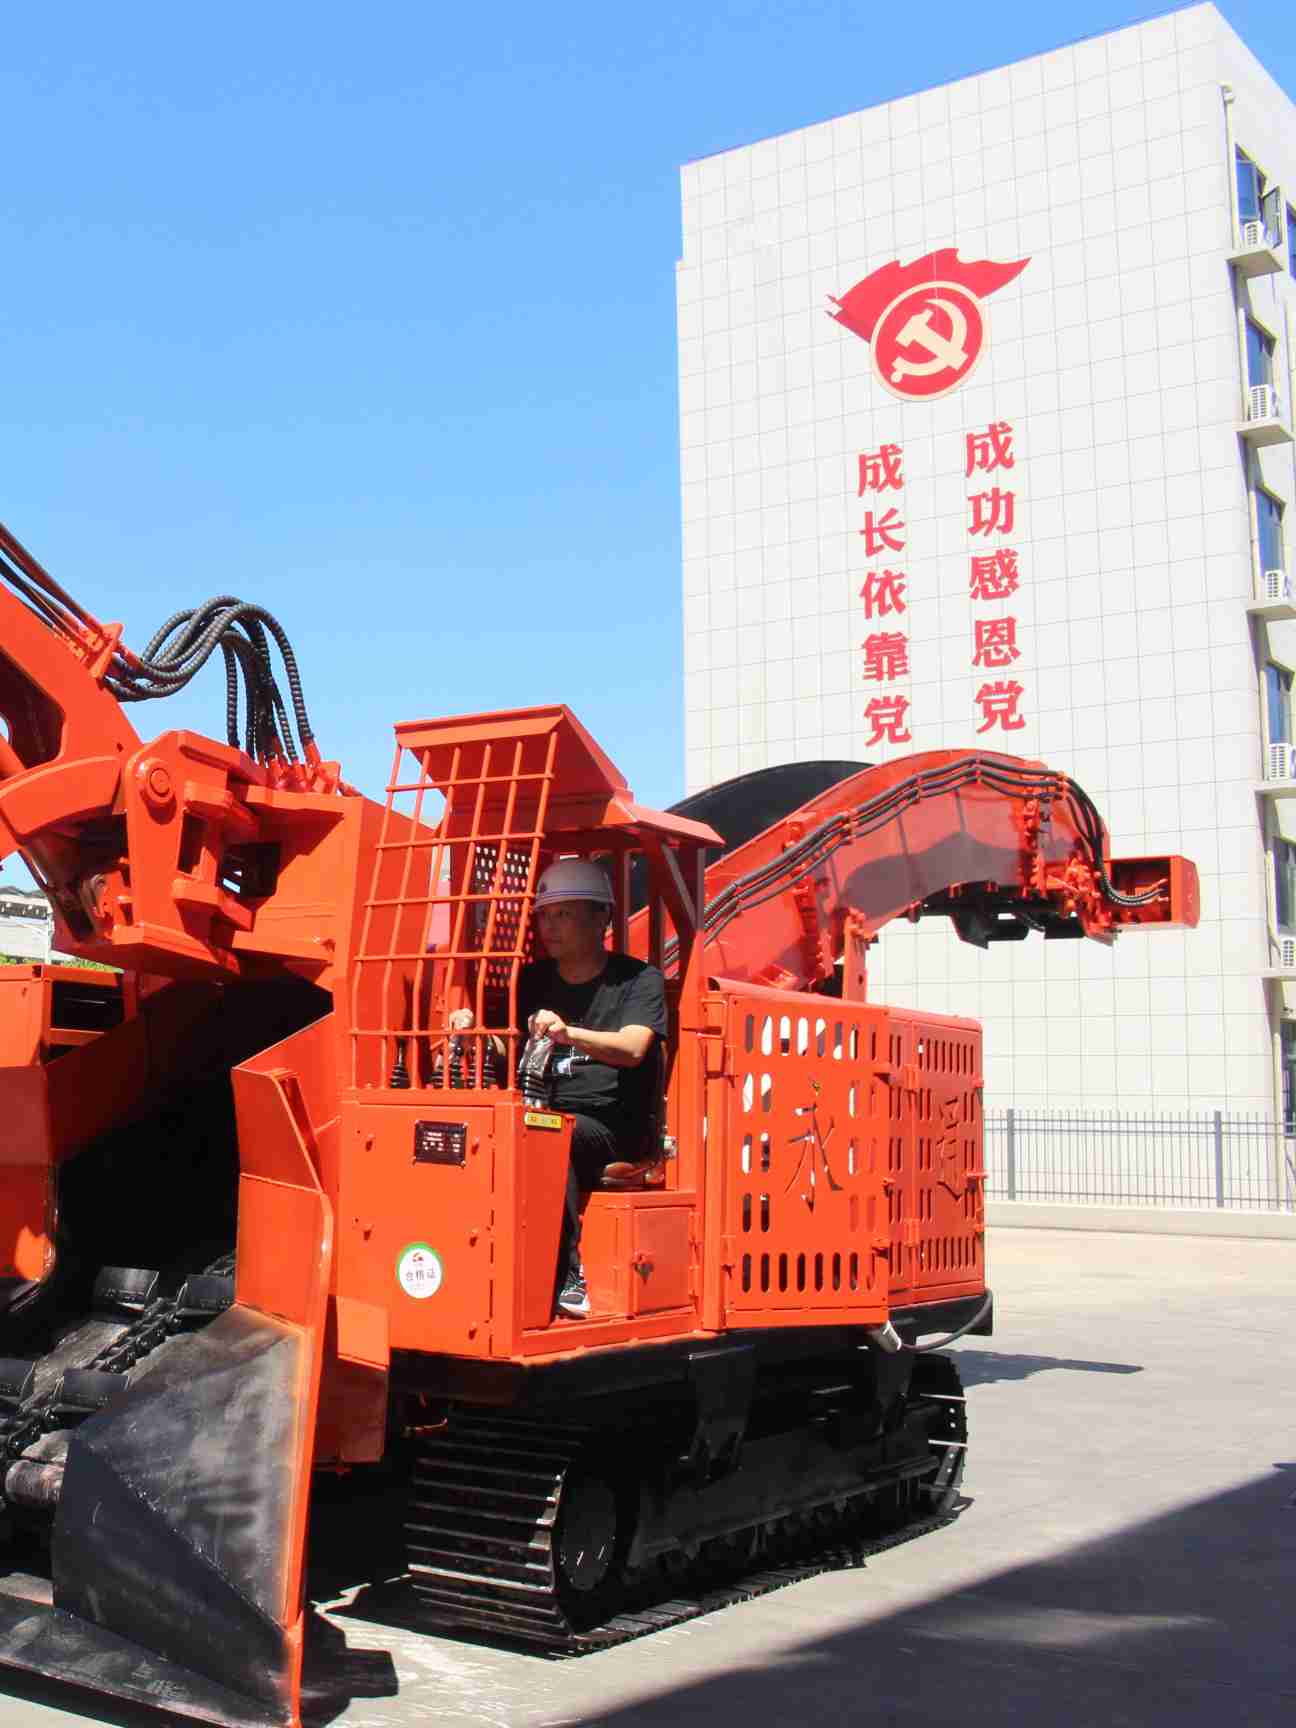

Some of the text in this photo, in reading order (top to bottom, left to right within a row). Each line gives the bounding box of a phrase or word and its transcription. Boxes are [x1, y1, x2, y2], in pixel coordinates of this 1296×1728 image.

[857, 443, 912, 746] 成长依靠党
[965, 421, 1026, 732] 成功感恩党
